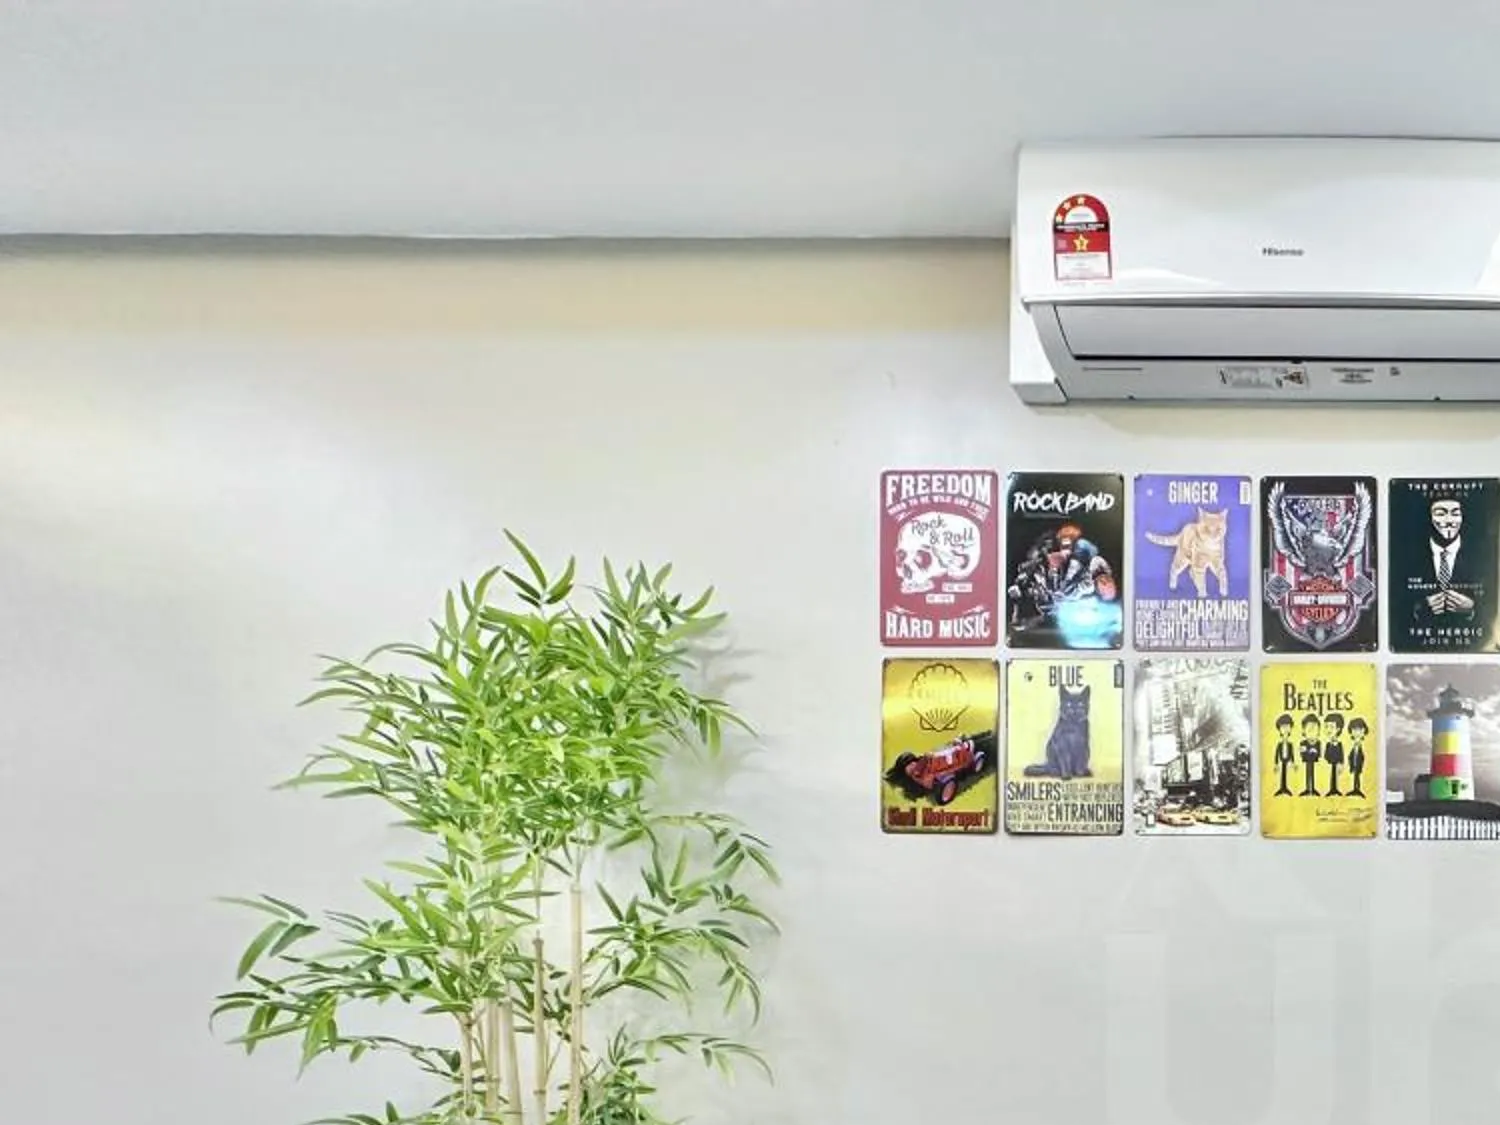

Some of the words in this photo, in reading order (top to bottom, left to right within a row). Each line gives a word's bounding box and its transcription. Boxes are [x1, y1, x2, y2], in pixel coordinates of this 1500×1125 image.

[886, 474, 992, 508] FREEDOM
[1013, 489, 1063, 514] ROCK
[1064, 490, 1115, 515] BAND
[1169, 481, 1218, 505] GINGER
[912, 515, 946, 537] Rock
[943, 527, 974, 547] Roll
[1180, 599, 1249, 621] CHARMING
[886, 611, 933, 639] HARD
[940, 611, 991, 639] MUSIC
[1049, 665, 1085, 687] BLUE
[1312, 679, 1327, 689] THE
[1284, 683, 1355, 716] BEATLES
[1007, 781, 1061, 801] SMILERS
[1048, 803, 1123, 822] ENTRANCING
